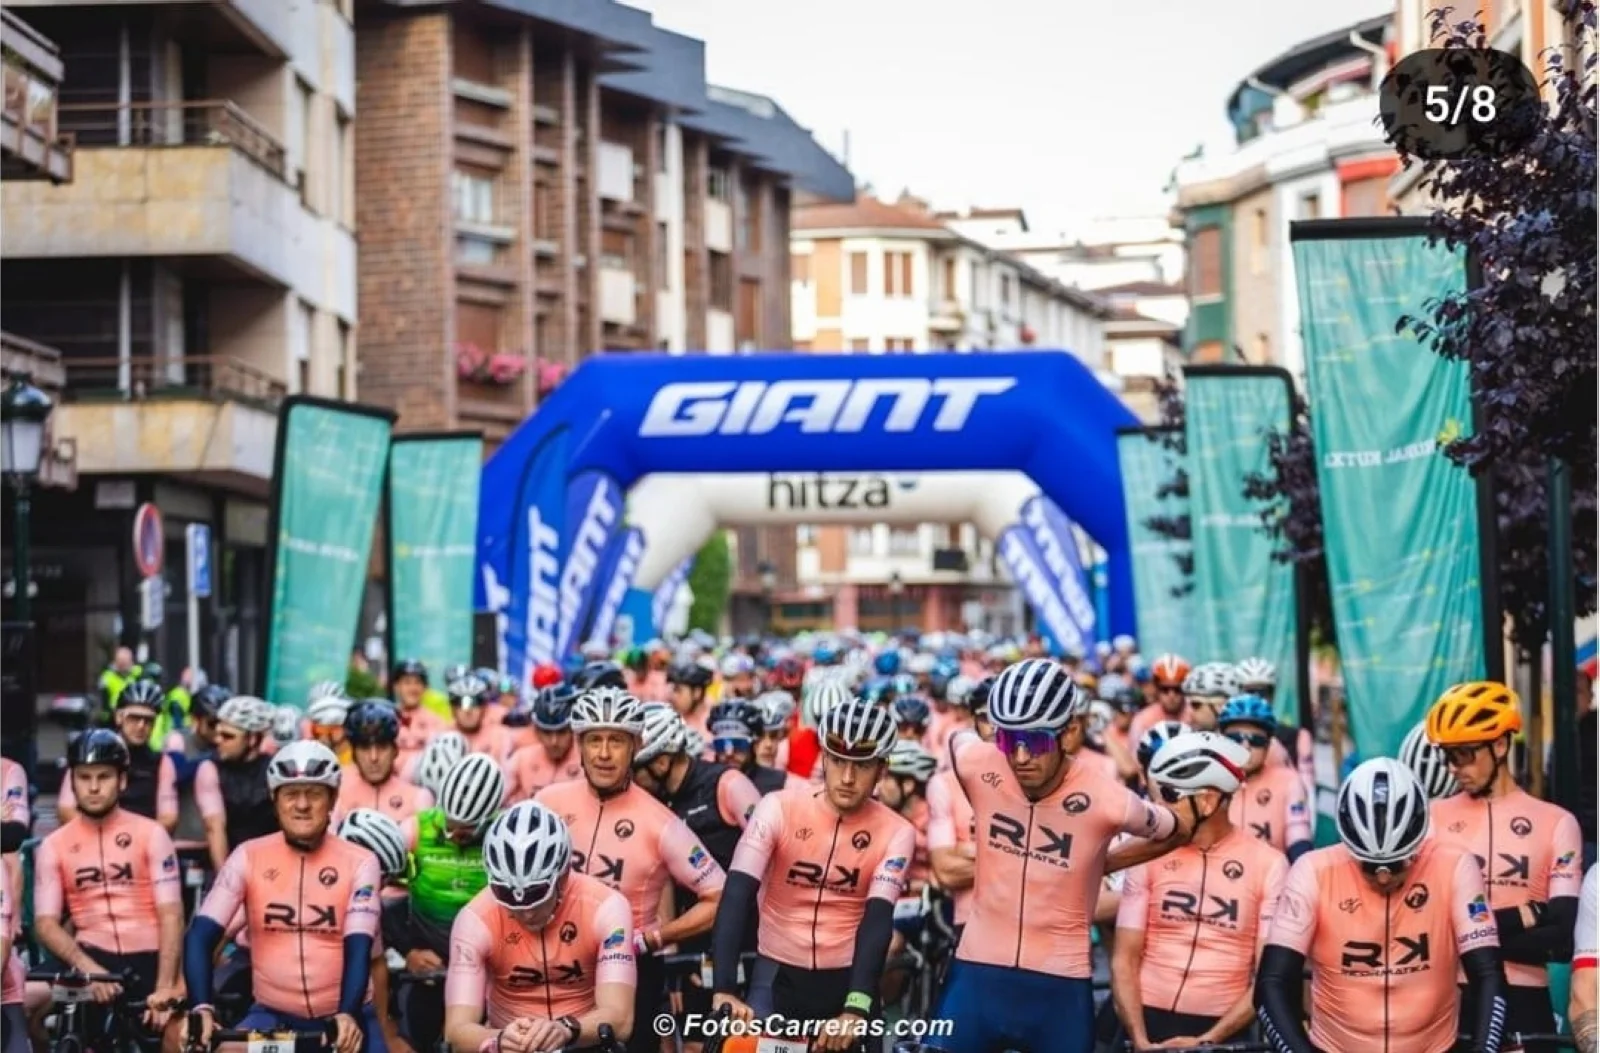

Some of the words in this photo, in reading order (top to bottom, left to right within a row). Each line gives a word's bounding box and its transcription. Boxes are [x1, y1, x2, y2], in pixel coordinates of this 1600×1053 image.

[638, 376, 1018, 437] GIANT
[767, 471, 891, 509] hitza
[988, 812, 1073, 860] RK
[786, 861, 861, 888] RK
[264, 903, 337, 928] RK
[1162, 890, 1238, 921] RK
[1341, 932, 1431, 968] RK
